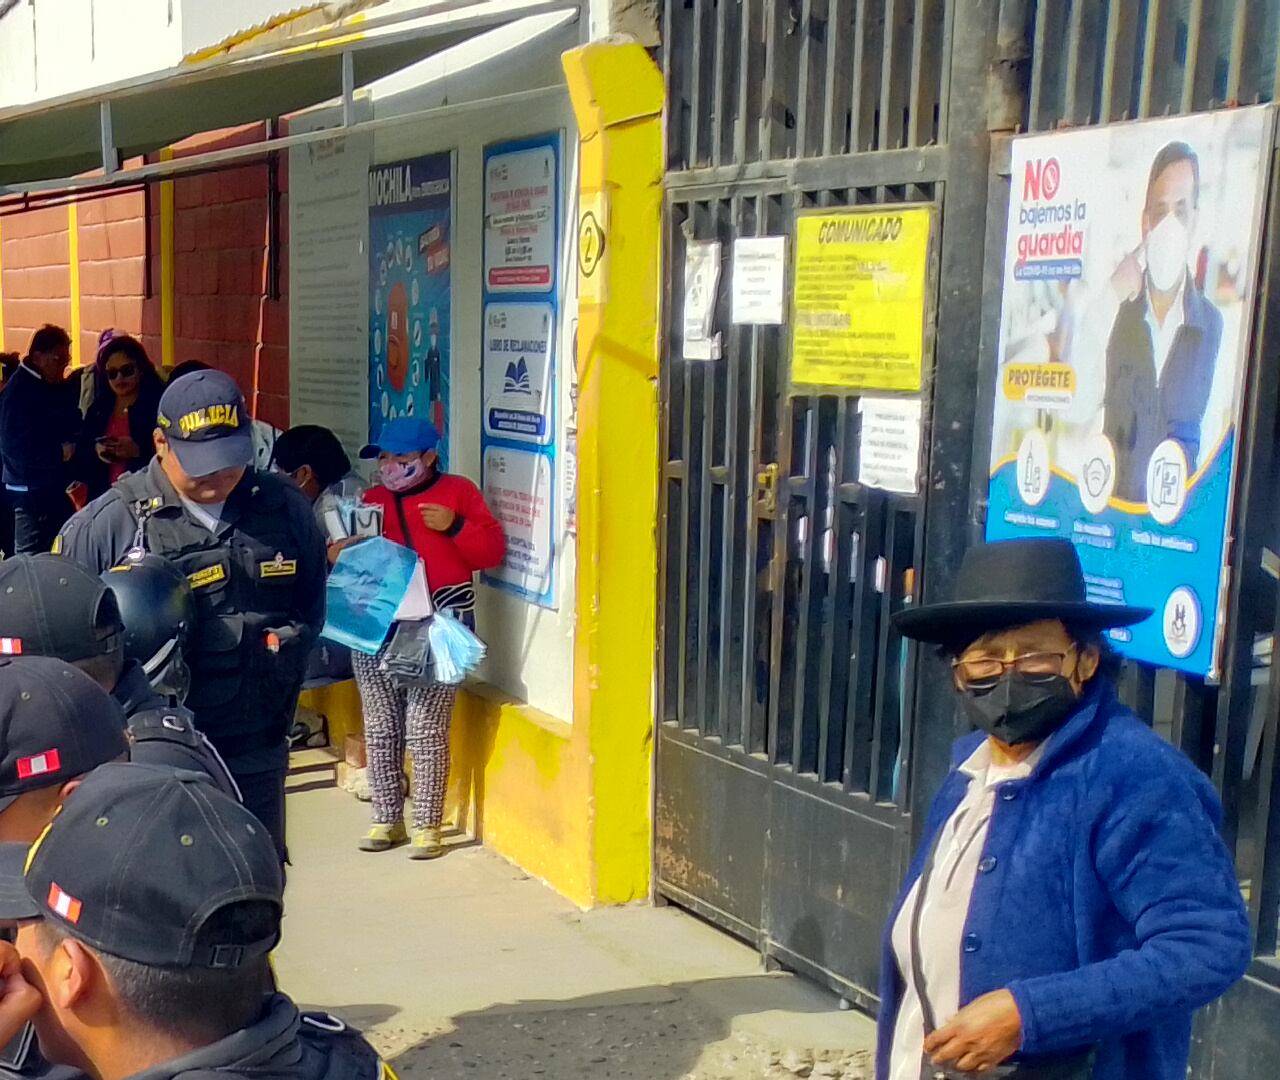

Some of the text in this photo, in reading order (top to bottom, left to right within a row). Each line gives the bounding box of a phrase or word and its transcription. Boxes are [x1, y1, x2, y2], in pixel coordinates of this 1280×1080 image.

[818, 216, 903, 245] COMUNICADO
[1020, 202, 1072, 228] bajemos
[584, 226, 592, 263] 2
[1018, 224, 1083, 268] guardia
